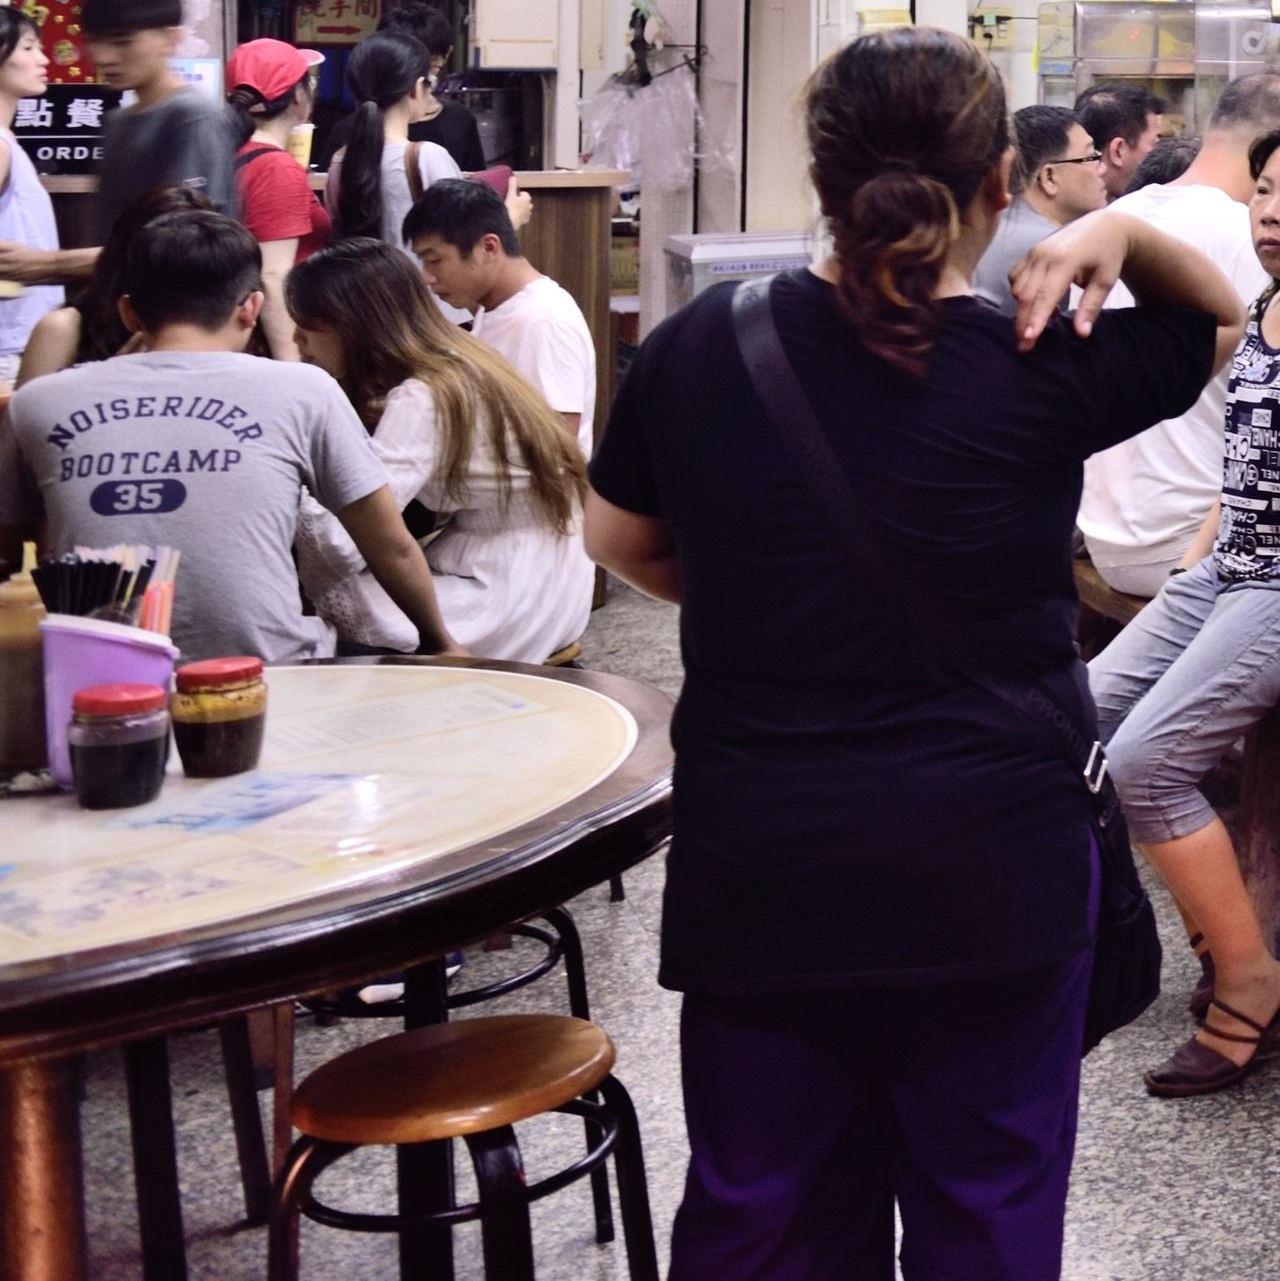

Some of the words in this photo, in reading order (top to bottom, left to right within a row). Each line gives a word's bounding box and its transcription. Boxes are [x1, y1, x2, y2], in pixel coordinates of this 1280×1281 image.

[46, 396, 264, 451] NOISERIDER
[60, 449, 241, 482] BOOTCAMP
[112, 482, 165, 511] 35
